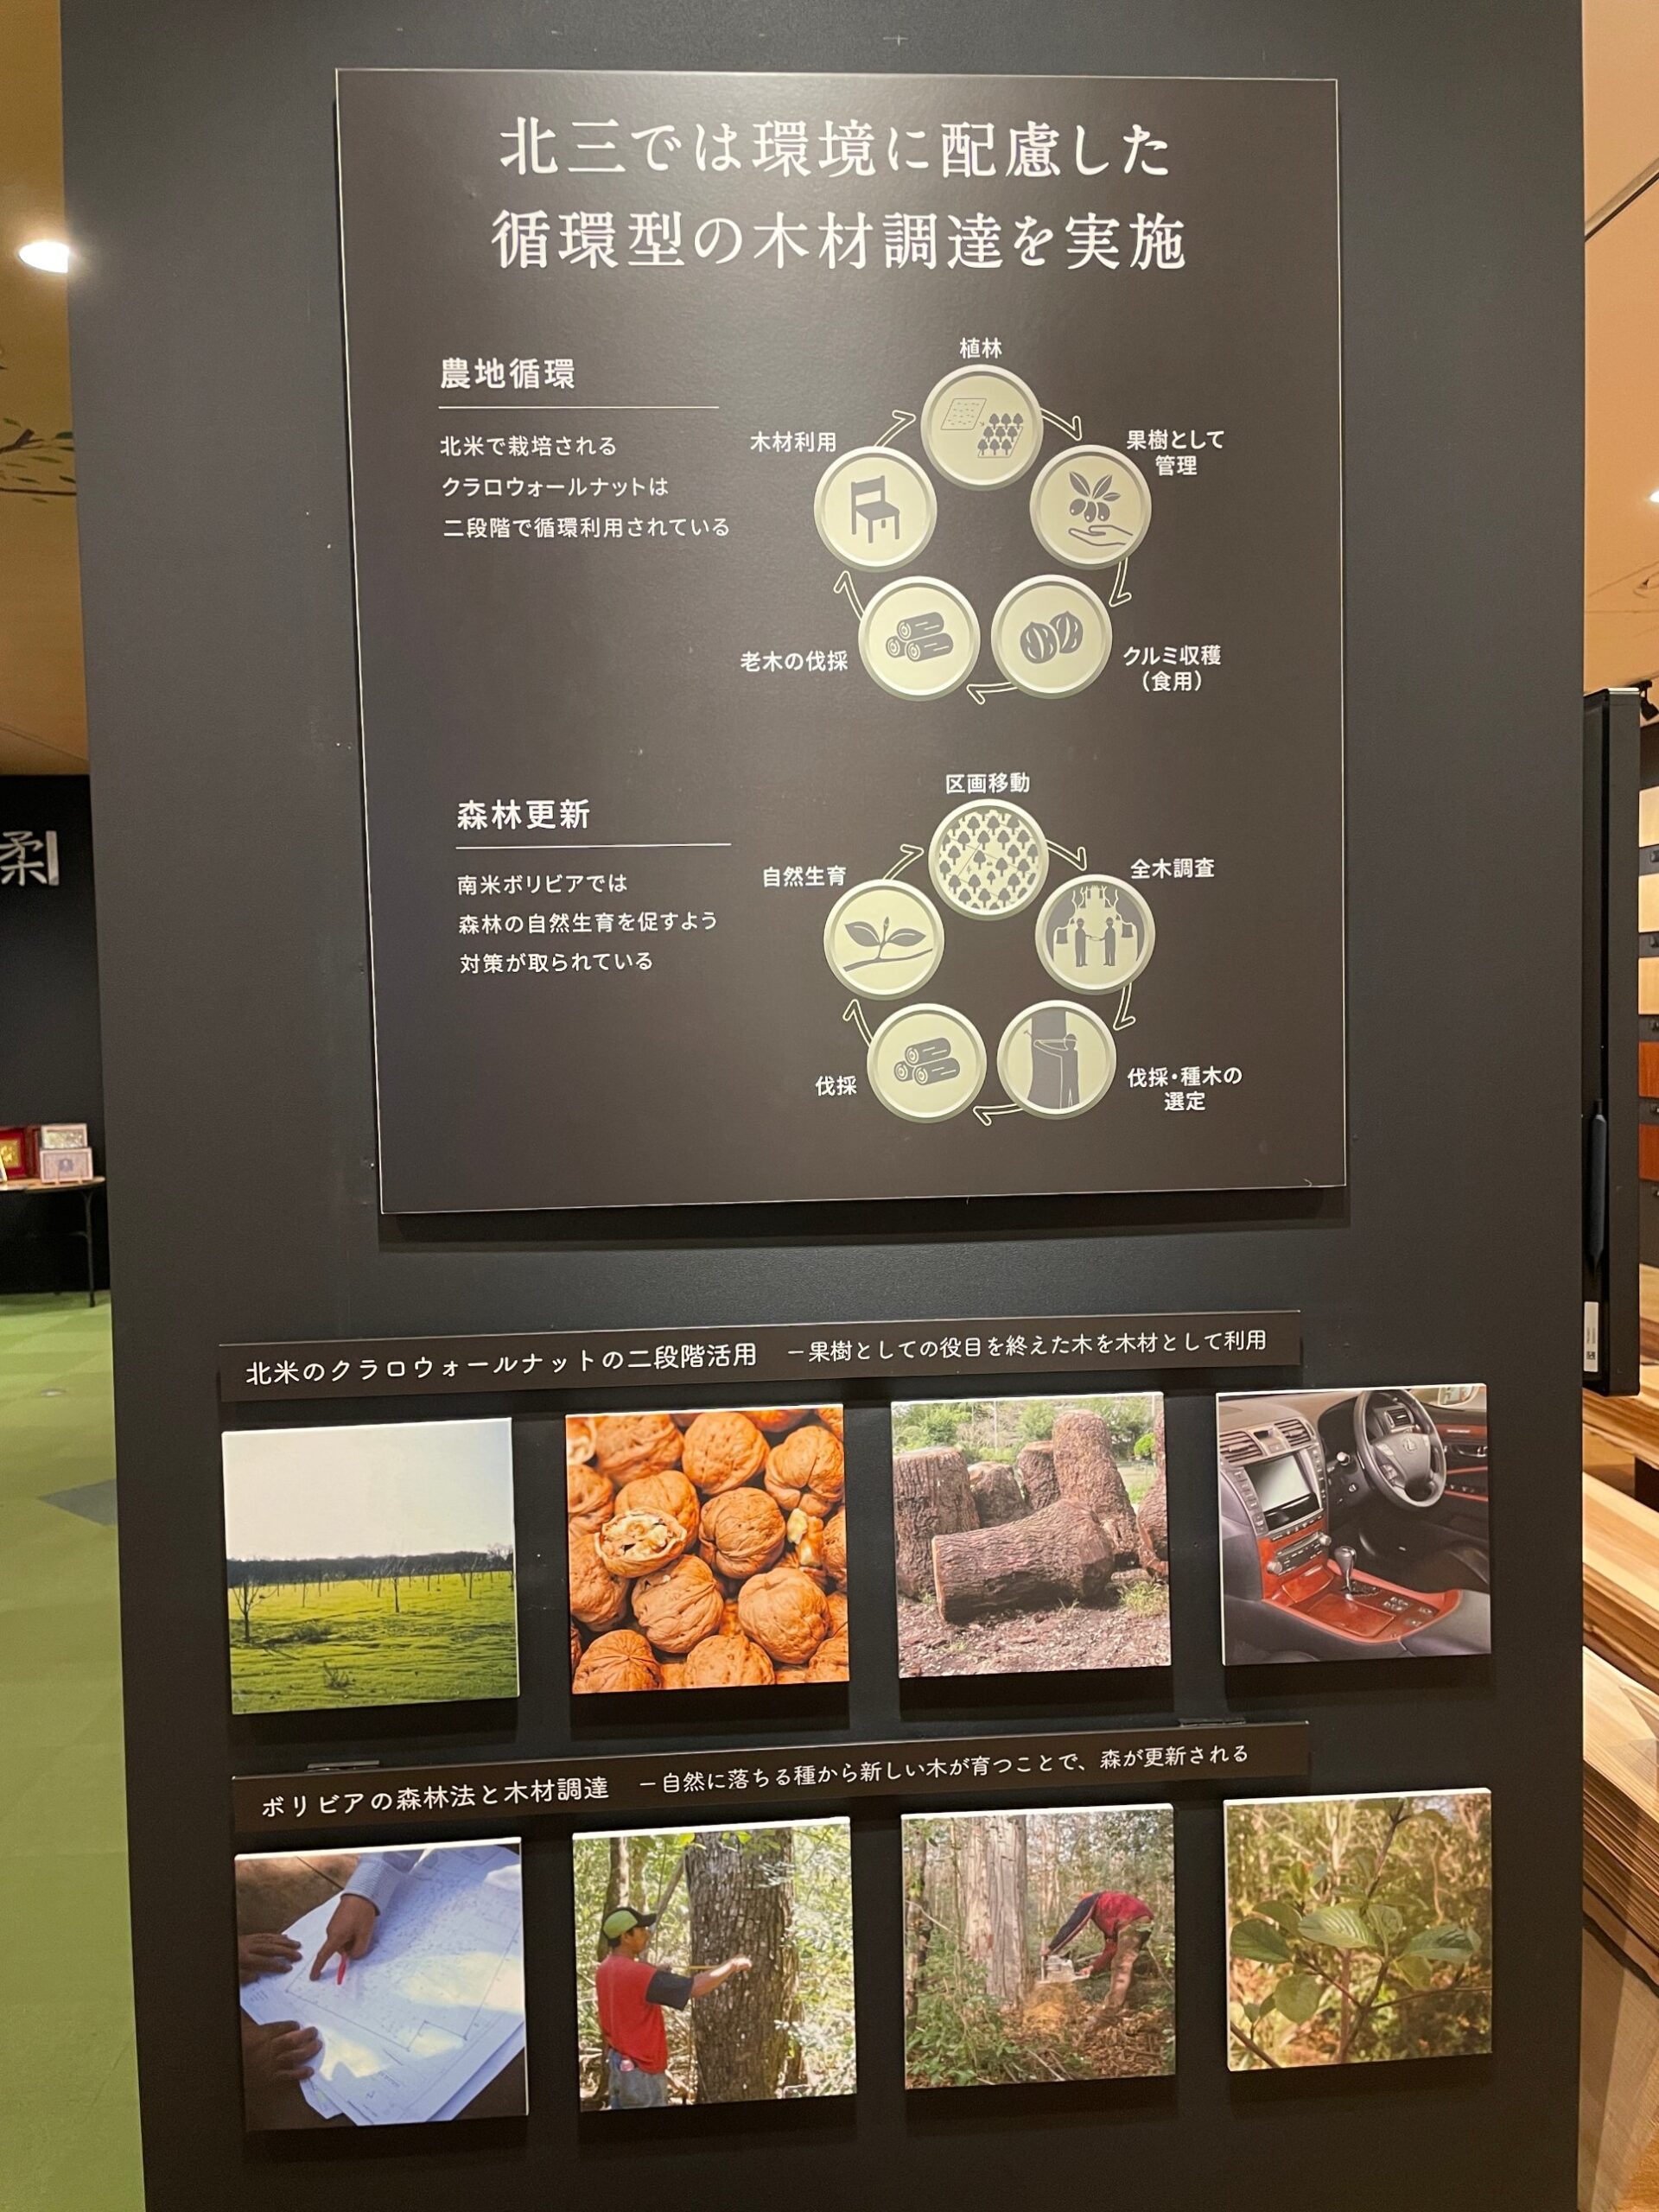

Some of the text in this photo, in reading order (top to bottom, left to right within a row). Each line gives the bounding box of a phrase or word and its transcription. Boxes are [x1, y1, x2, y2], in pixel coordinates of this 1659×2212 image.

[500, 116, 1168, 178] 北三では環境に配慮した
[491, 209, 1185, 270] 循環型の木材調達を実施
[959, 337, 1002, 359] 植林
[441, 357, 575, 390] 農地循環
[440, 435, 616, 457] 北米で栽培される
[750, 430, 836, 453] 木材利用
[1126, 429, 1224, 451] 果樹として
[1154, 454, 1198, 476] 管理
[442, 476, 669, 498] クラロウォールナットは
[443, 517, 729, 538] 二段階で循環利用されている
[740, 650, 849, 672] 老木の伐採
[1122, 644, 1222, 666] クルミ収穫
[945, 772, 1030, 795] 区画移動
[457, 798, 590, 830] 森林更新
[763, 865, 847, 887] 自然生育
[1130, 857, 1215, 880] 全木調査
[457, 874, 627, 896] 南米ボリビアでは
[459, 911, 717, 935] 森林の自然生育を促すよう
[460, 951, 652, 974] 対策が取られている
[815, 1075, 857, 1096] 伐採
[1164, 1090, 1205, 1111] 選定
[245, 1342, 756, 1386] 北米のクラロウォールナットの二段階活用
[262, 1776, 609, 1818] ボリビアの森林法と木材調達
